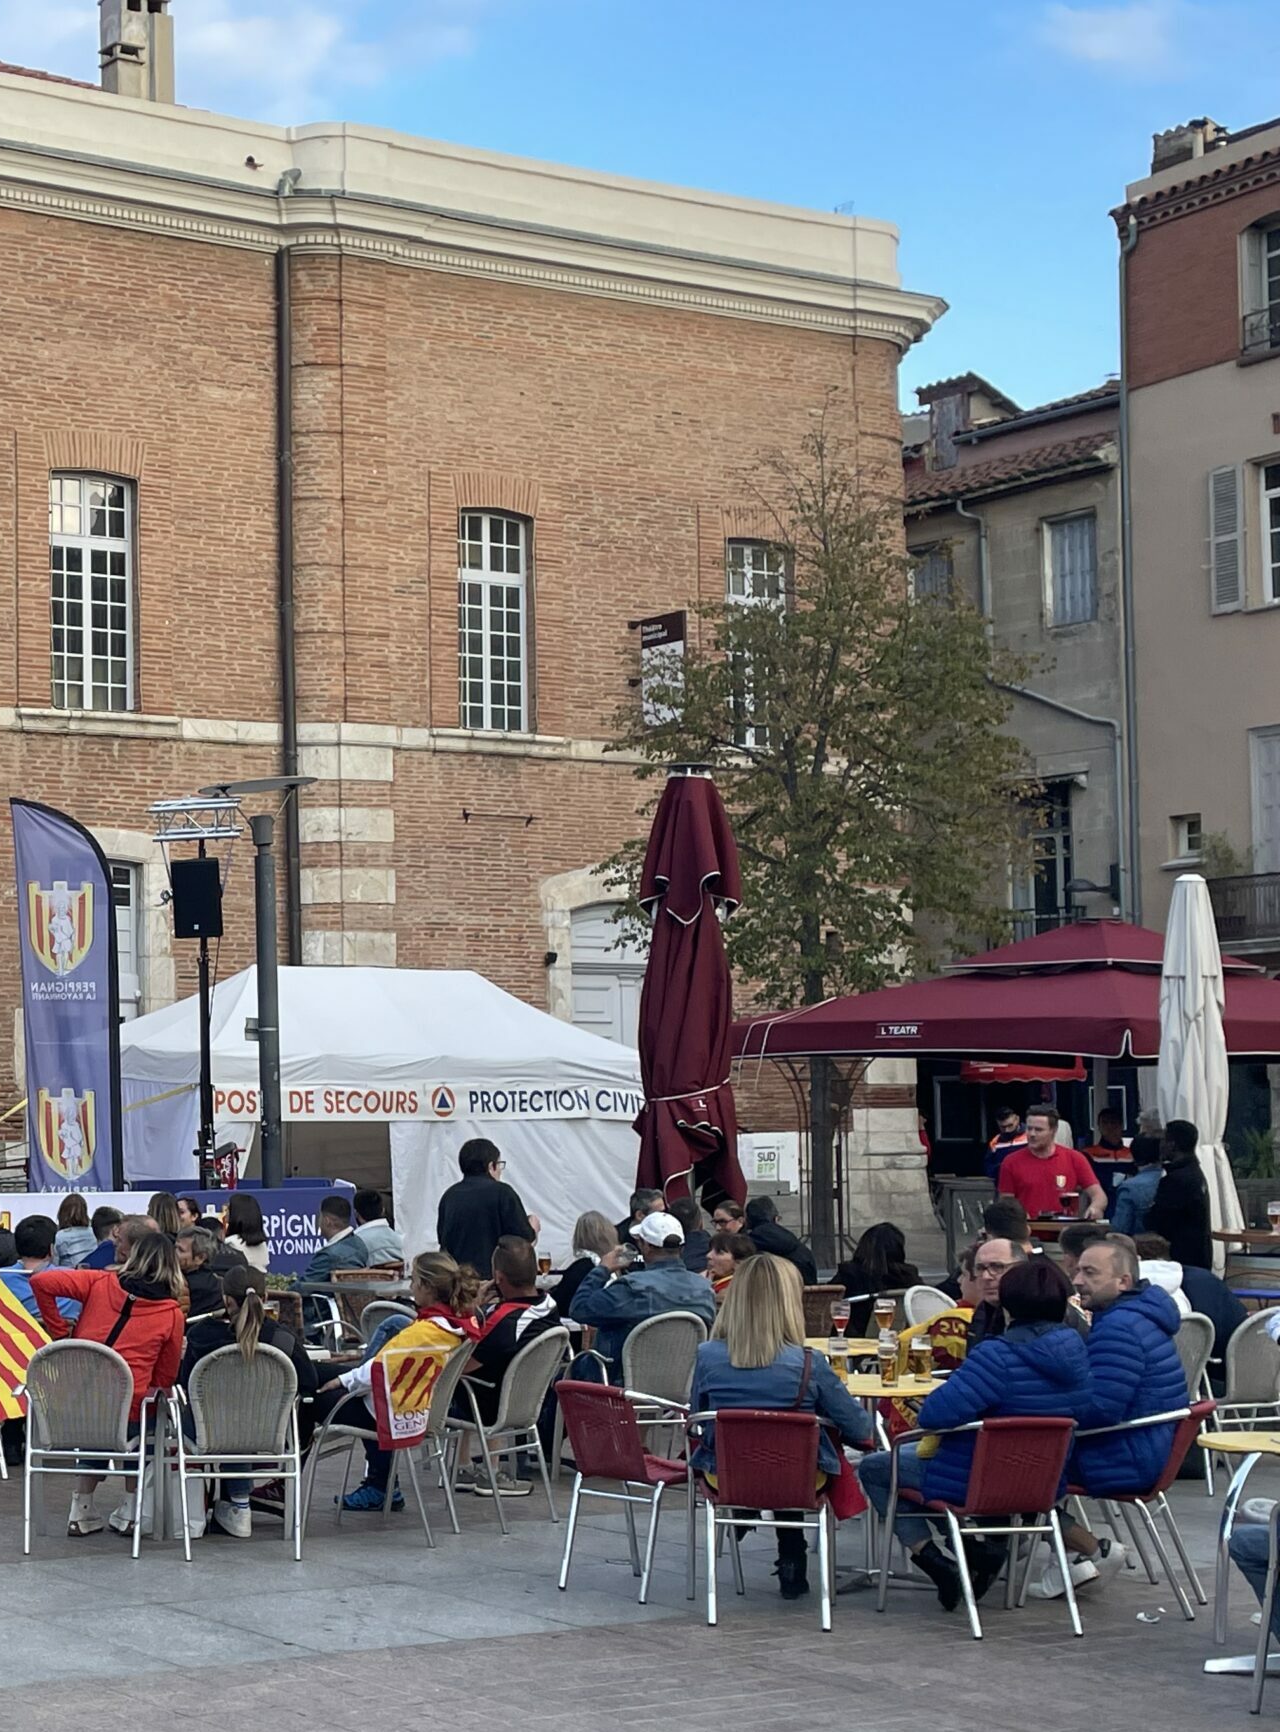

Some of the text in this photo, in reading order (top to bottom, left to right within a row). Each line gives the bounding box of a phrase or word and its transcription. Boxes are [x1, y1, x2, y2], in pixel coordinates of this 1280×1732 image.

[214, 1090, 258, 1114] POS
[288, 1090, 315, 1114] DE
[324, 1090, 419, 1114] SECOURS
[469, 1089, 590, 1113] PROTECTION
[756, 1151, 777, 1162] SUD
[756, 1163, 776, 1173] BTP
